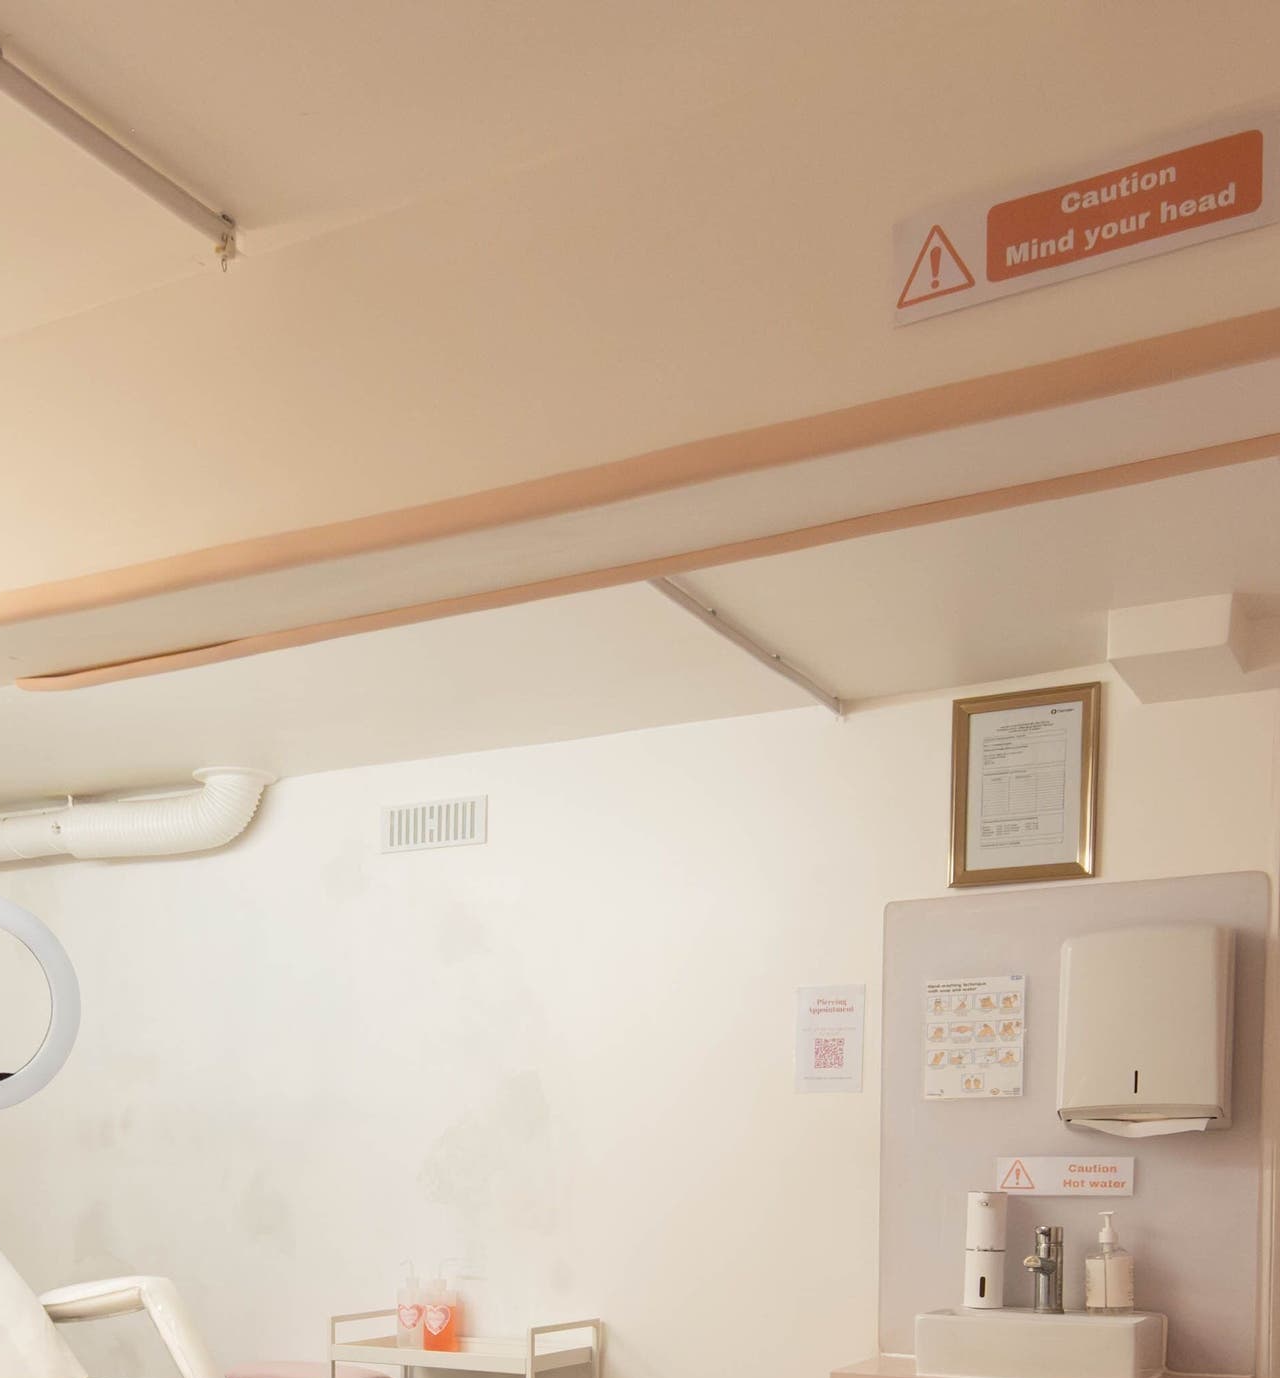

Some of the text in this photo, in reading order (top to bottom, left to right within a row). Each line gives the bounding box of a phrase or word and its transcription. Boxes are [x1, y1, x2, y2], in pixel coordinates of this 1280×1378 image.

[1060, 164, 1177, 214] Caution
[1005, 183, 1237, 267] Mind your head
[1062, 1179, 1126, 1188] Hot water
[1068, 1164, 1118, 1174] Caution
